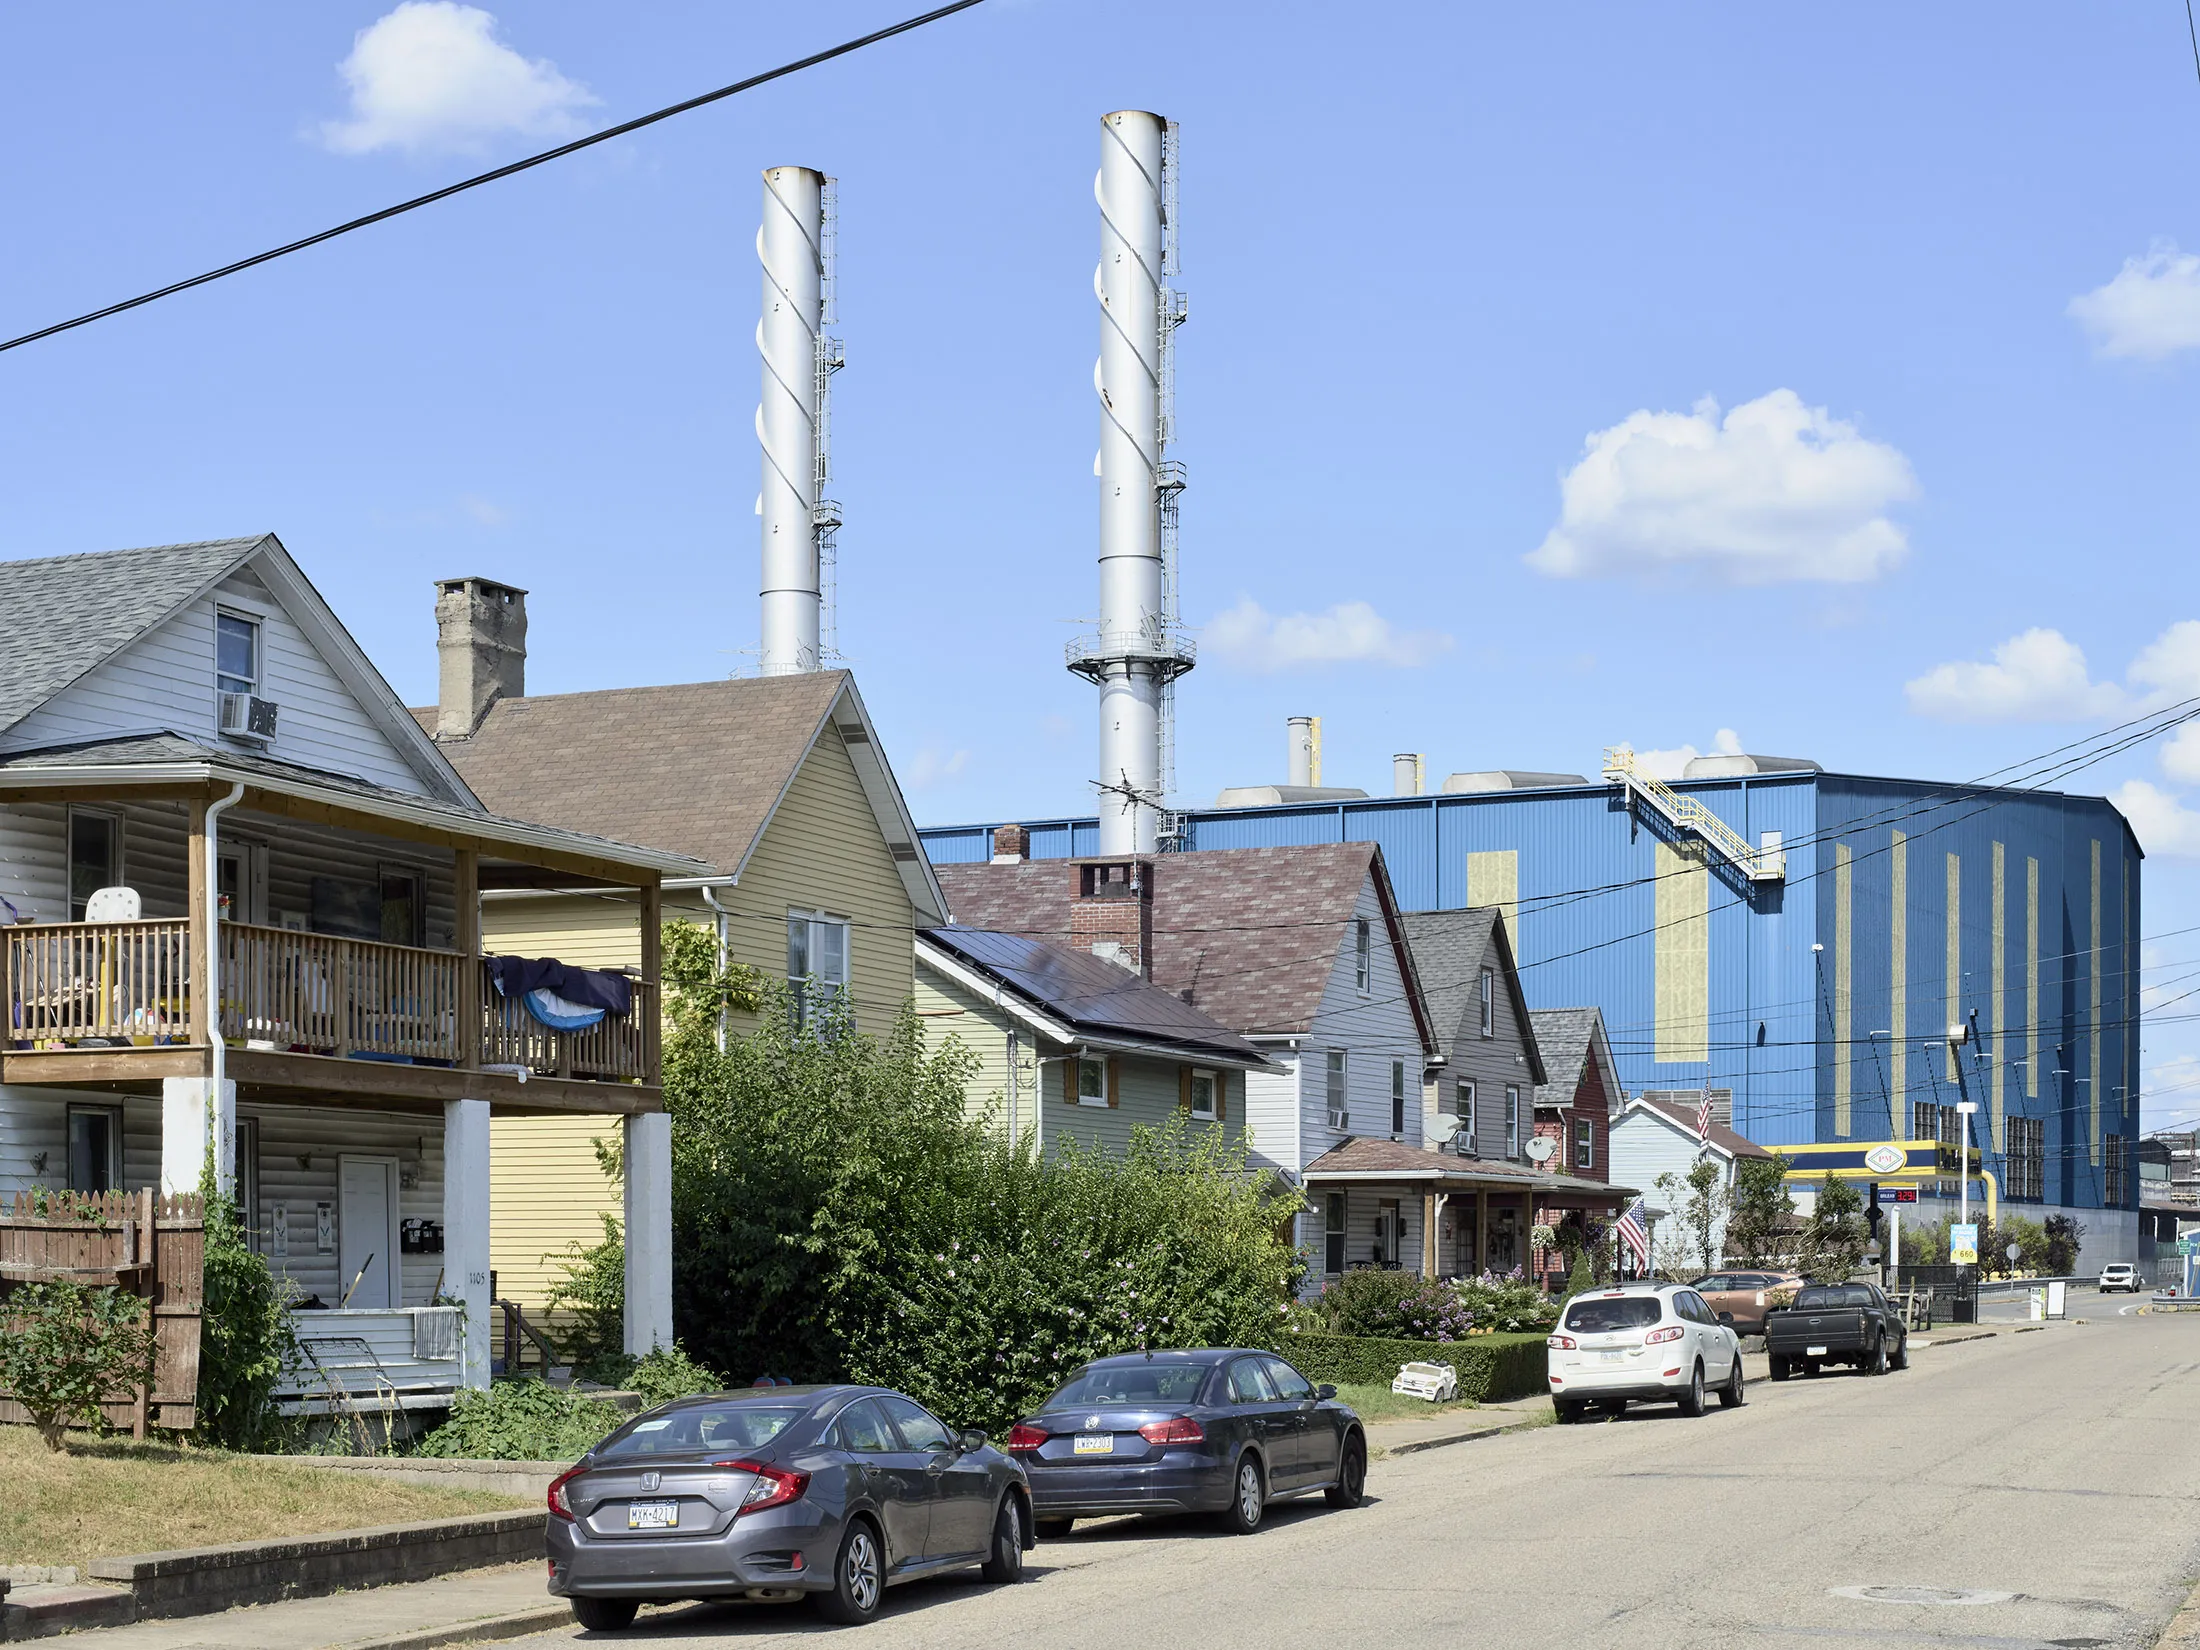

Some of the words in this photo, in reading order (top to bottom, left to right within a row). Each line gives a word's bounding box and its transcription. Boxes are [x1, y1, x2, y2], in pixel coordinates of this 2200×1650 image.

[1878, 1155, 1892, 1163] PM
[1959, 1250, 1974, 1258] 660
[469, 1271, 485, 1286] 1105
